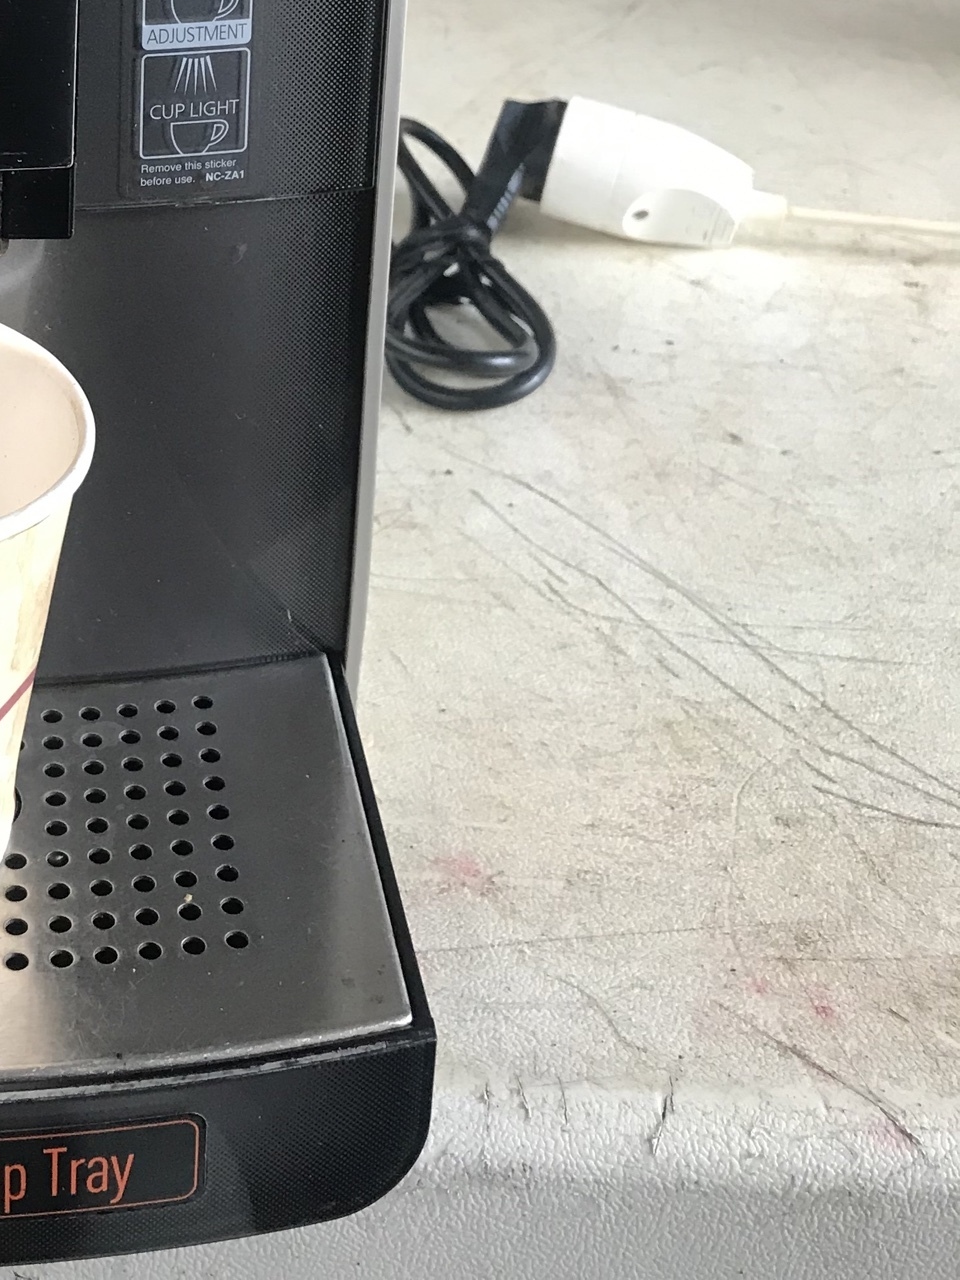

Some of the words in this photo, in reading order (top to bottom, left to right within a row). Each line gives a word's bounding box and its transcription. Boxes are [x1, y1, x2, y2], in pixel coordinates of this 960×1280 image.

[146, 23, 247, 45] ADJUSTMENT
[149, 103, 186, 120] CUP
[189, 99, 240, 118] LIGHT
[141, 163, 182, 174] Remove
[185, 160, 202, 170] this
[205, 158, 237, 169] sticker
[140, 176, 172, 187] before
[174, 174, 196, 184] use.
[205, 169, 245, 182] NC-ZA1
[43, 1146, 135, 1203] Tray
